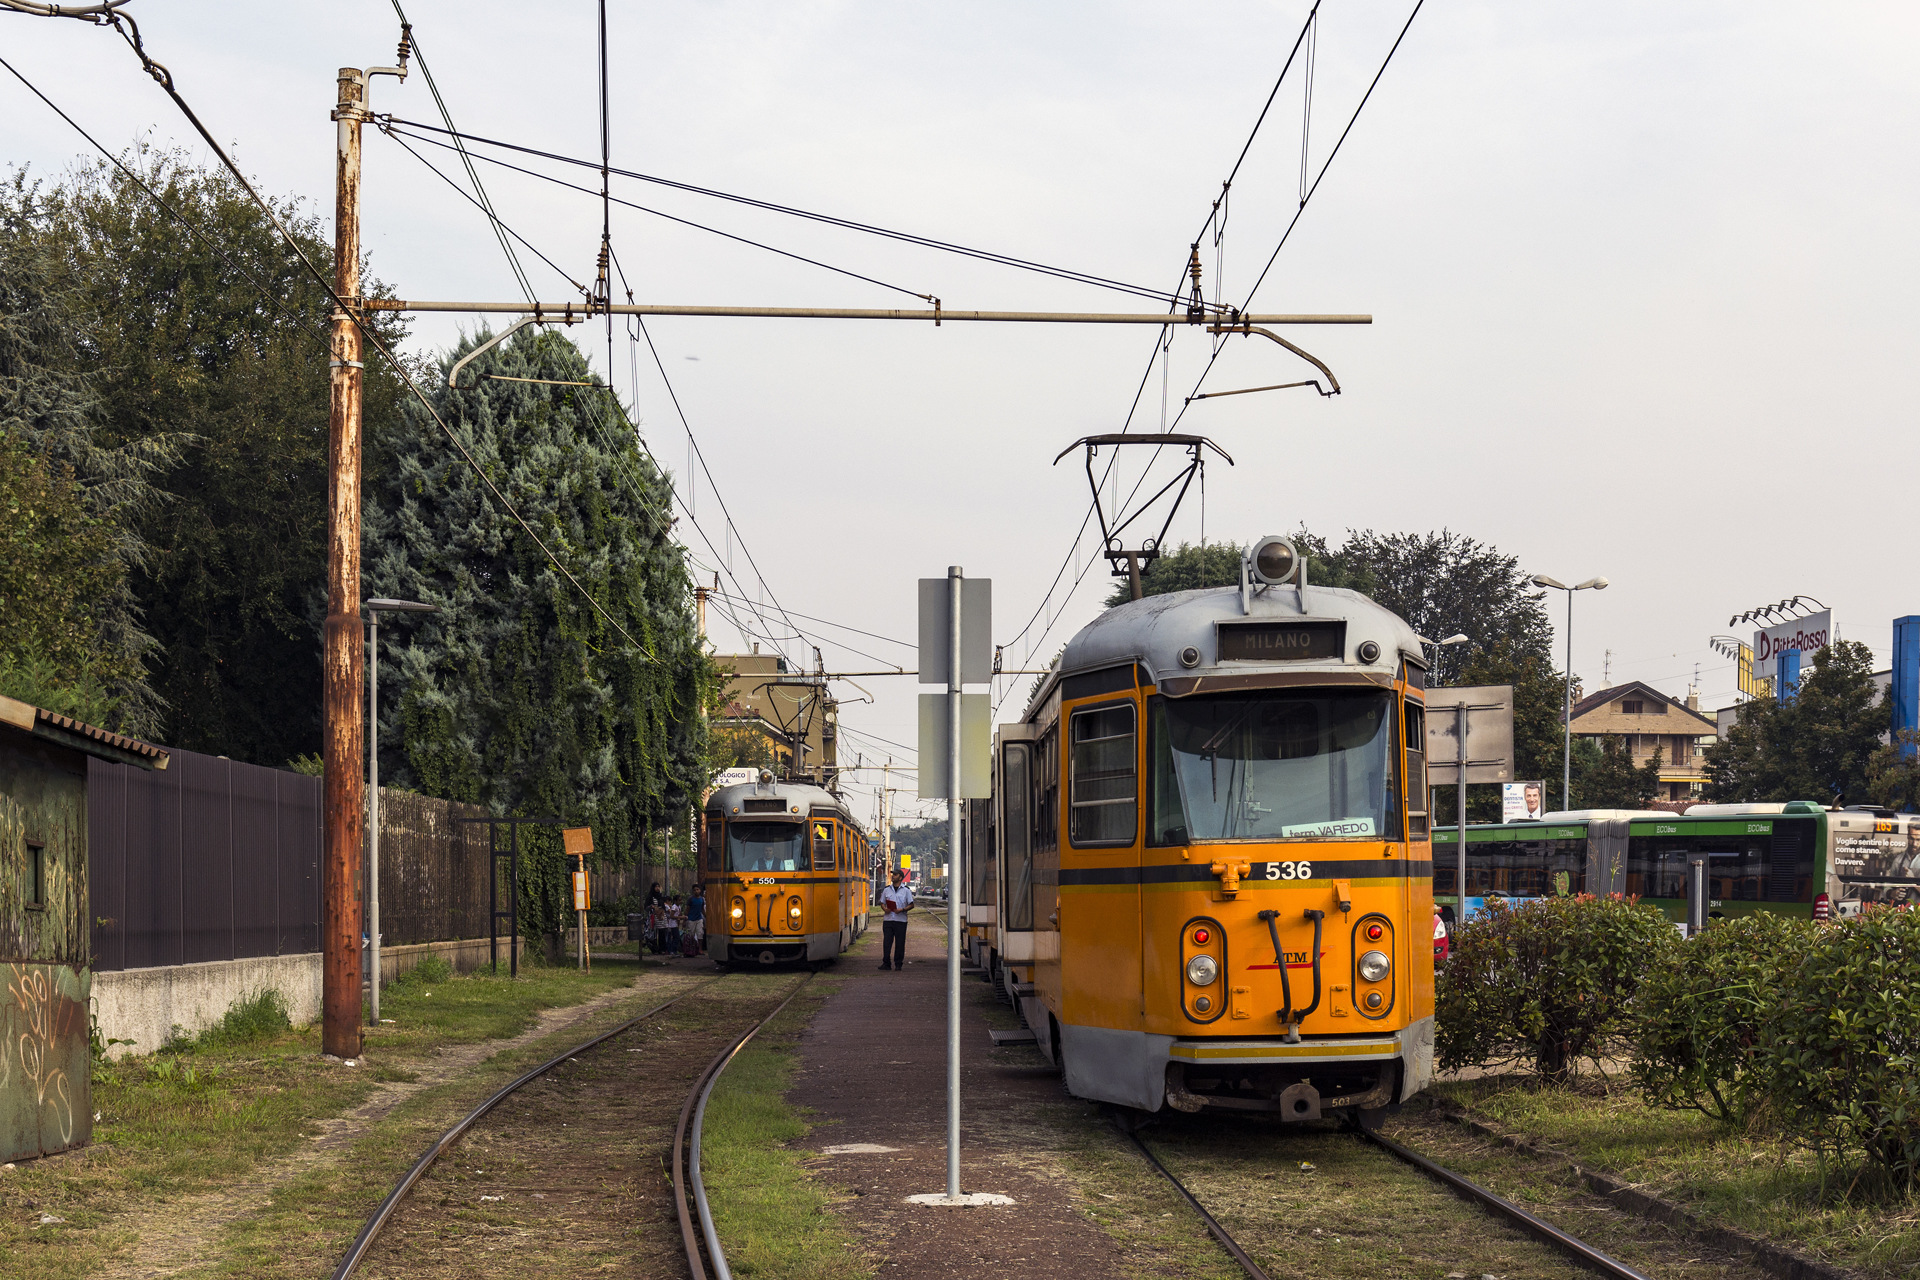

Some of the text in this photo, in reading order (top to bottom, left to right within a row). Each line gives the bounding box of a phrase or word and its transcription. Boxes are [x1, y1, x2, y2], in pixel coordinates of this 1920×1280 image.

[1245, 633, 1311, 649] MILANO
[1773, 629, 1827, 659] PittaRosso
[1318, 822, 1369, 836] VAREDO
[1656, 825, 1677, 833] ECObus
[1747, 824, 1770, 832] ECObus
[1876, 818, 1892, 832] 165
[1835, 837, 1858, 847] Voglio
[1858, 838, 1883, 847] sentire
[1882, 838, 1890, 847] le
[1856, 847, 1882, 855] stanno.
[1834, 857, 1866, 866] Davvero.
[1265, 861, 1312, 880] 536
[758, 877, 775, 885] 550
[1331, 1096, 1350, 1108] 503
